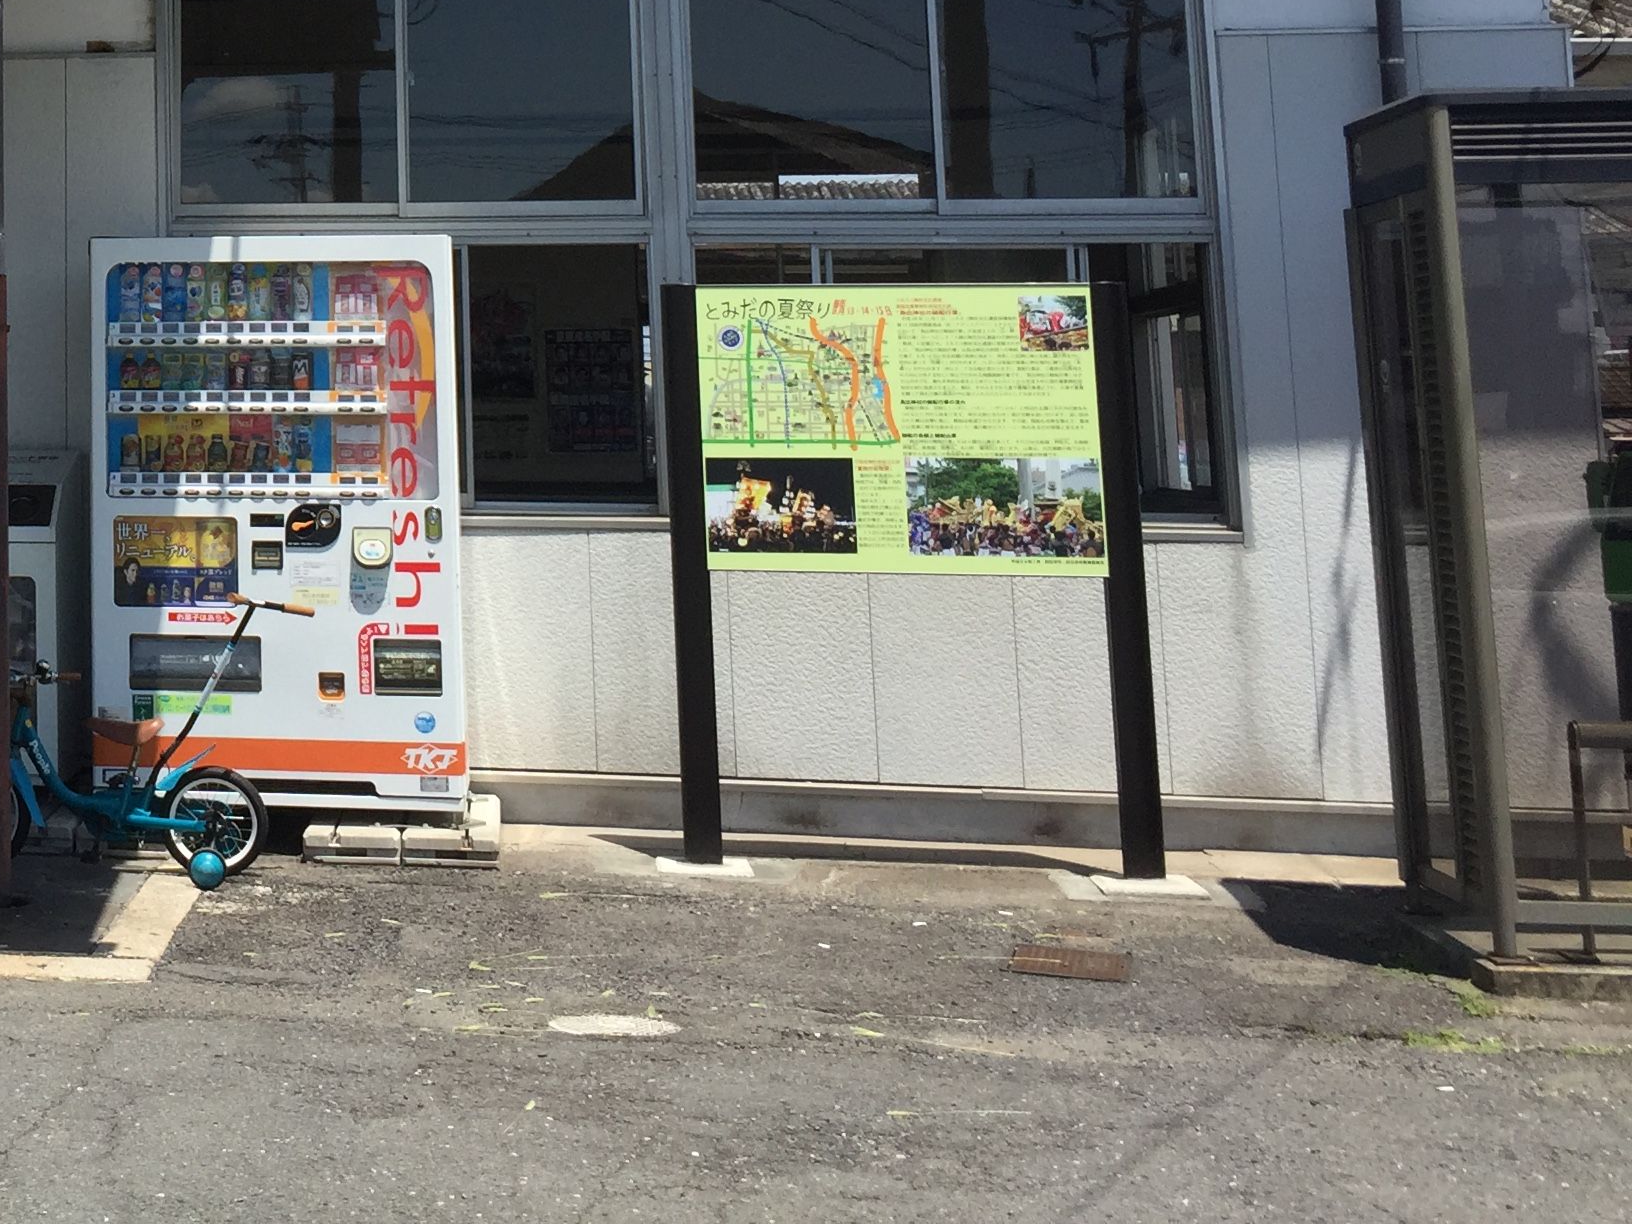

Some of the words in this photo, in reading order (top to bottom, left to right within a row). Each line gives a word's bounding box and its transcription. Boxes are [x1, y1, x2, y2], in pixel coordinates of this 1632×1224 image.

[706, 297, 831, 320] とみだの夏祭り
[115, 542, 197, 562] リニューアル。
[29, 738, 52, 774] People
